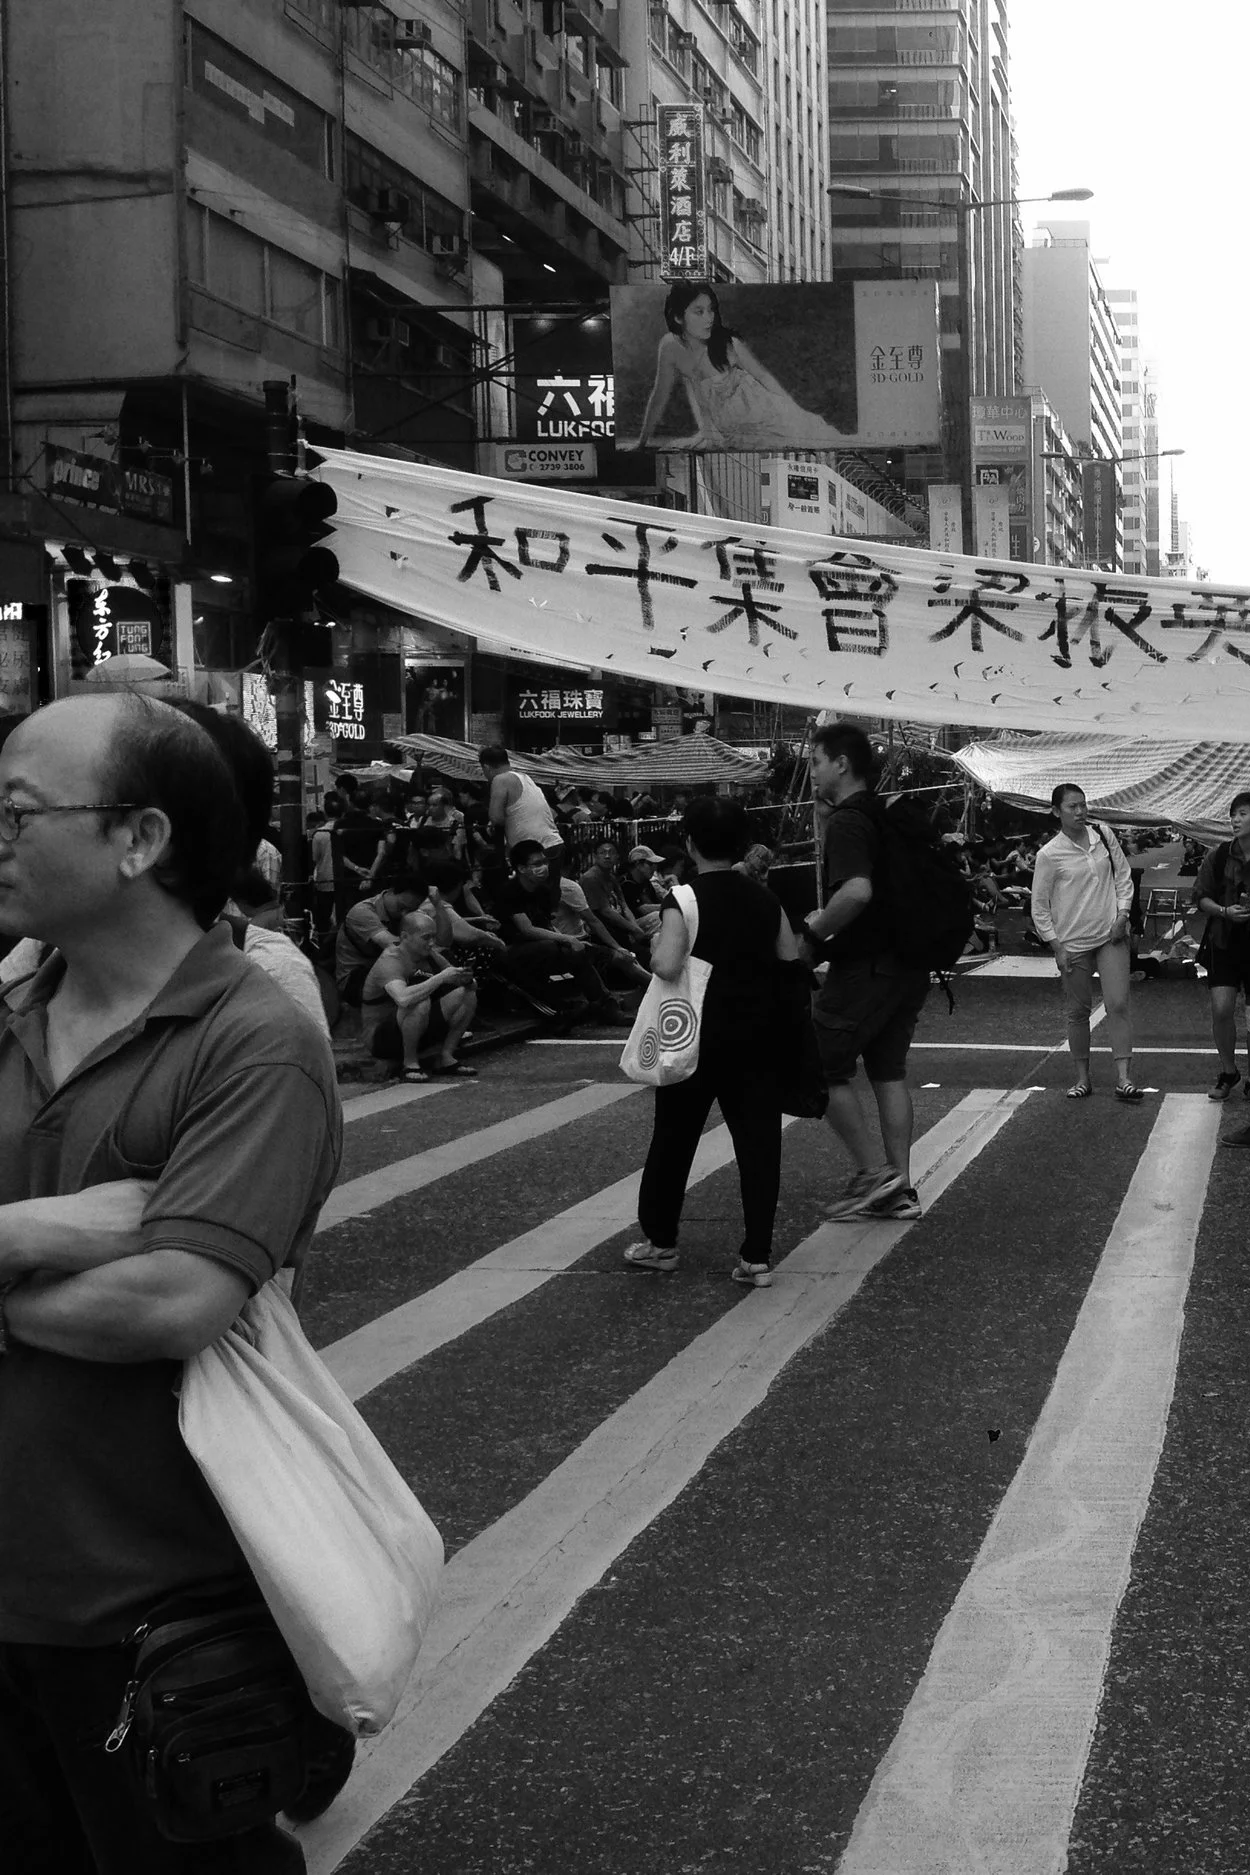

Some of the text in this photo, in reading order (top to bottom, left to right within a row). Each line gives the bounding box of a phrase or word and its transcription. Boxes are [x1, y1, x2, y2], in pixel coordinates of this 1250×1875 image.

[870, 345, 924, 370] 金至尊
[528, 450, 584, 462] CONVEY
[126, 643, 148, 653] UNG
[518, 689, 604, 710] 六福珠寶
[519, 710, 604, 719] LUKFOOK JEWELLERY
